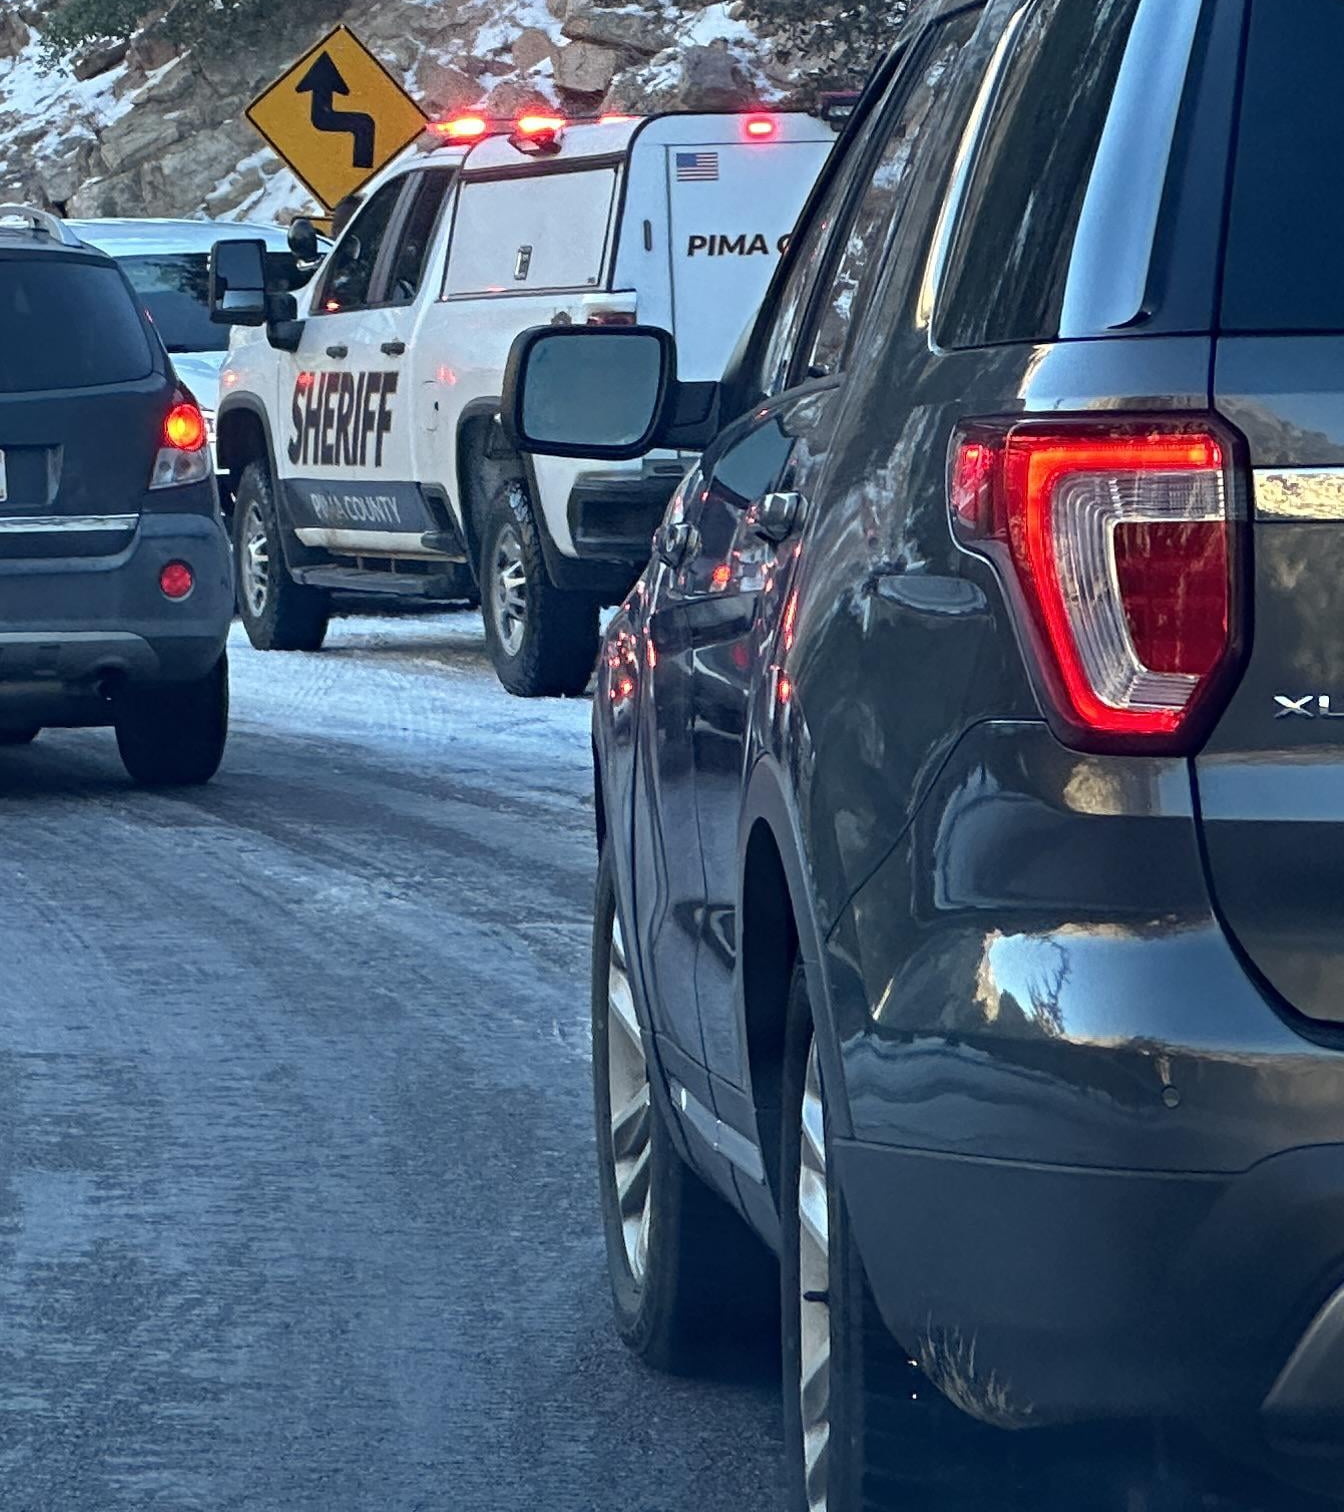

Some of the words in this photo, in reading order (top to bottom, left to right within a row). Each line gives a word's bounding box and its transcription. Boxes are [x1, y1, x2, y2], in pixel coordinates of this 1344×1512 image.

[687, 233, 769, 257] PIMA
[288, 371, 399, 468] SHERIFF
[343, 495, 400, 524] COUNTY
